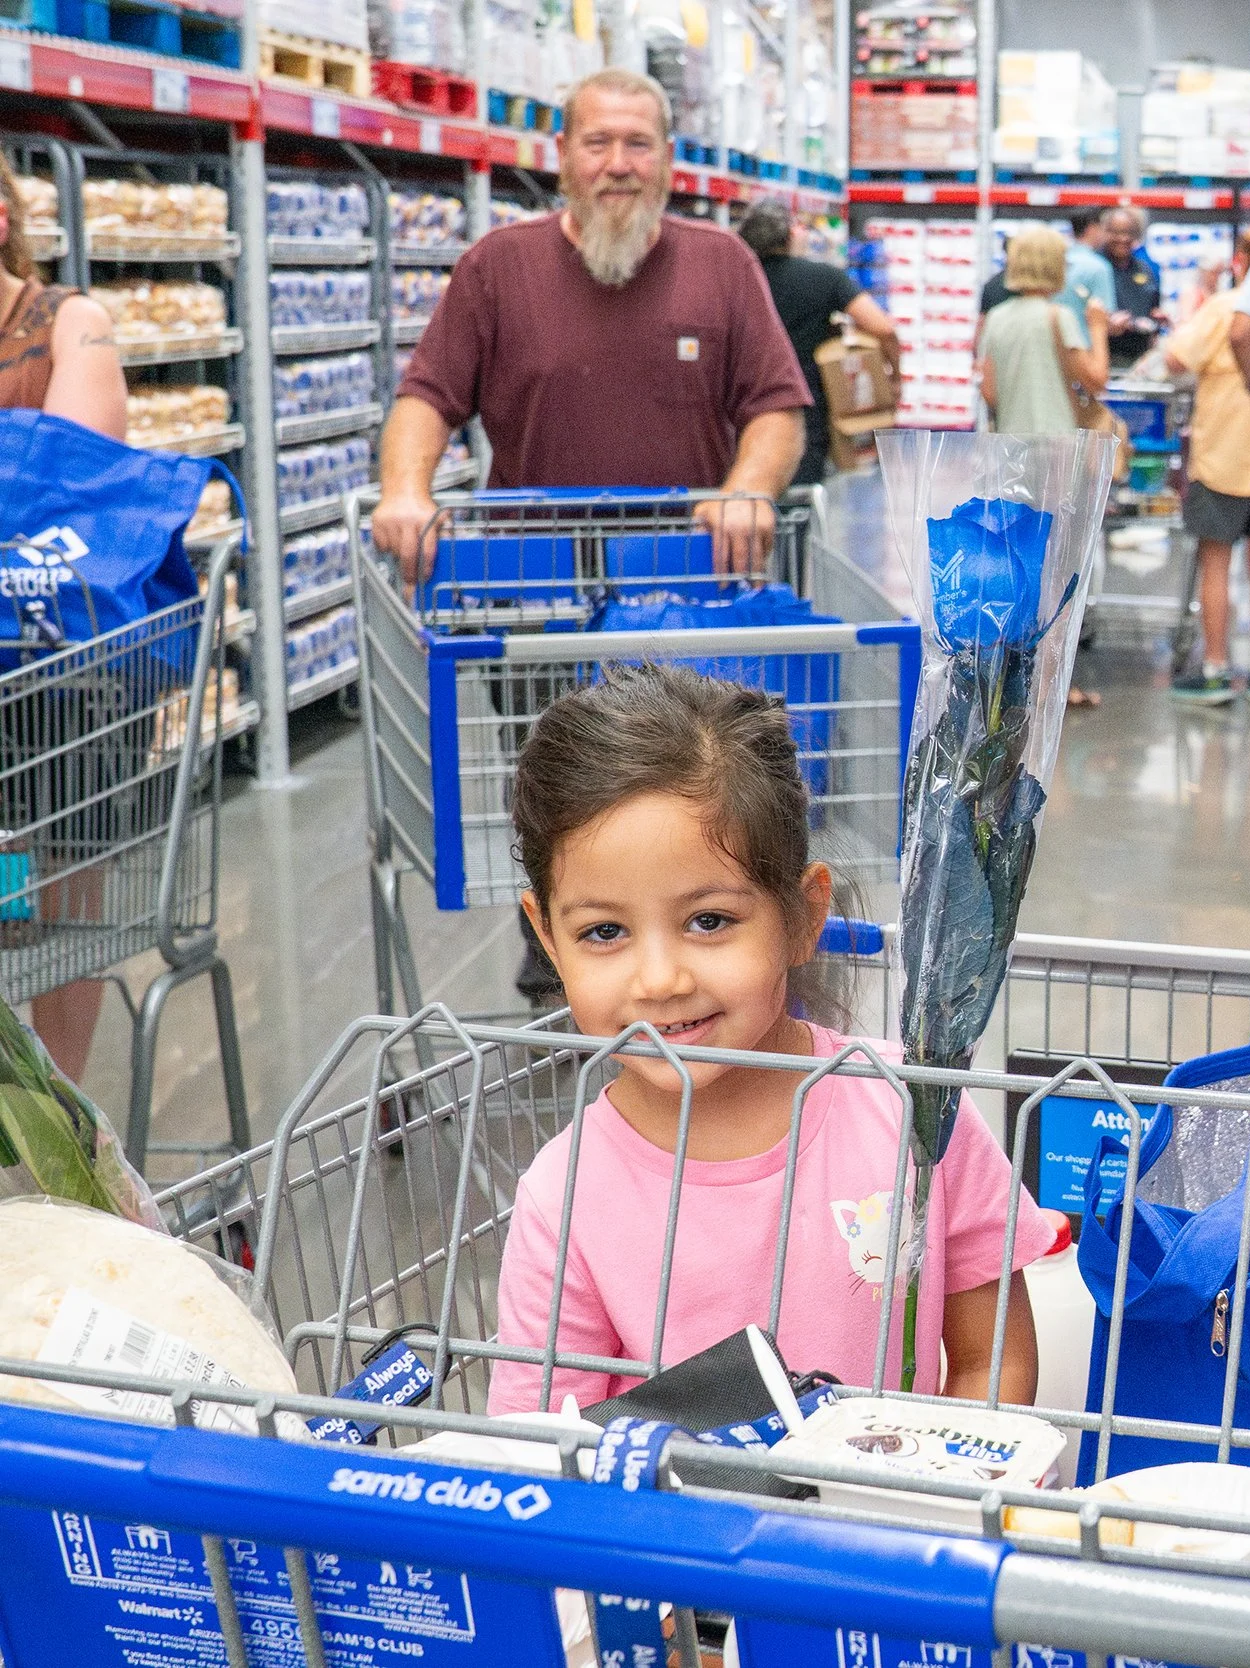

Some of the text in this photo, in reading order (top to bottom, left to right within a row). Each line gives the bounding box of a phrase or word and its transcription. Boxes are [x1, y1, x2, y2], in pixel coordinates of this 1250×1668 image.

[364, 1350, 416, 1395] Always
[381, 1377, 420, 1407] Seat
[595, 1432, 626, 1484] Belts
[622, 1450, 651, 1492] Use
[328, 1468, 503, 1511] sam's club
[118, 1599, 183, 1621] Walmart
[377, 1637, 425, 1658] CLUB
